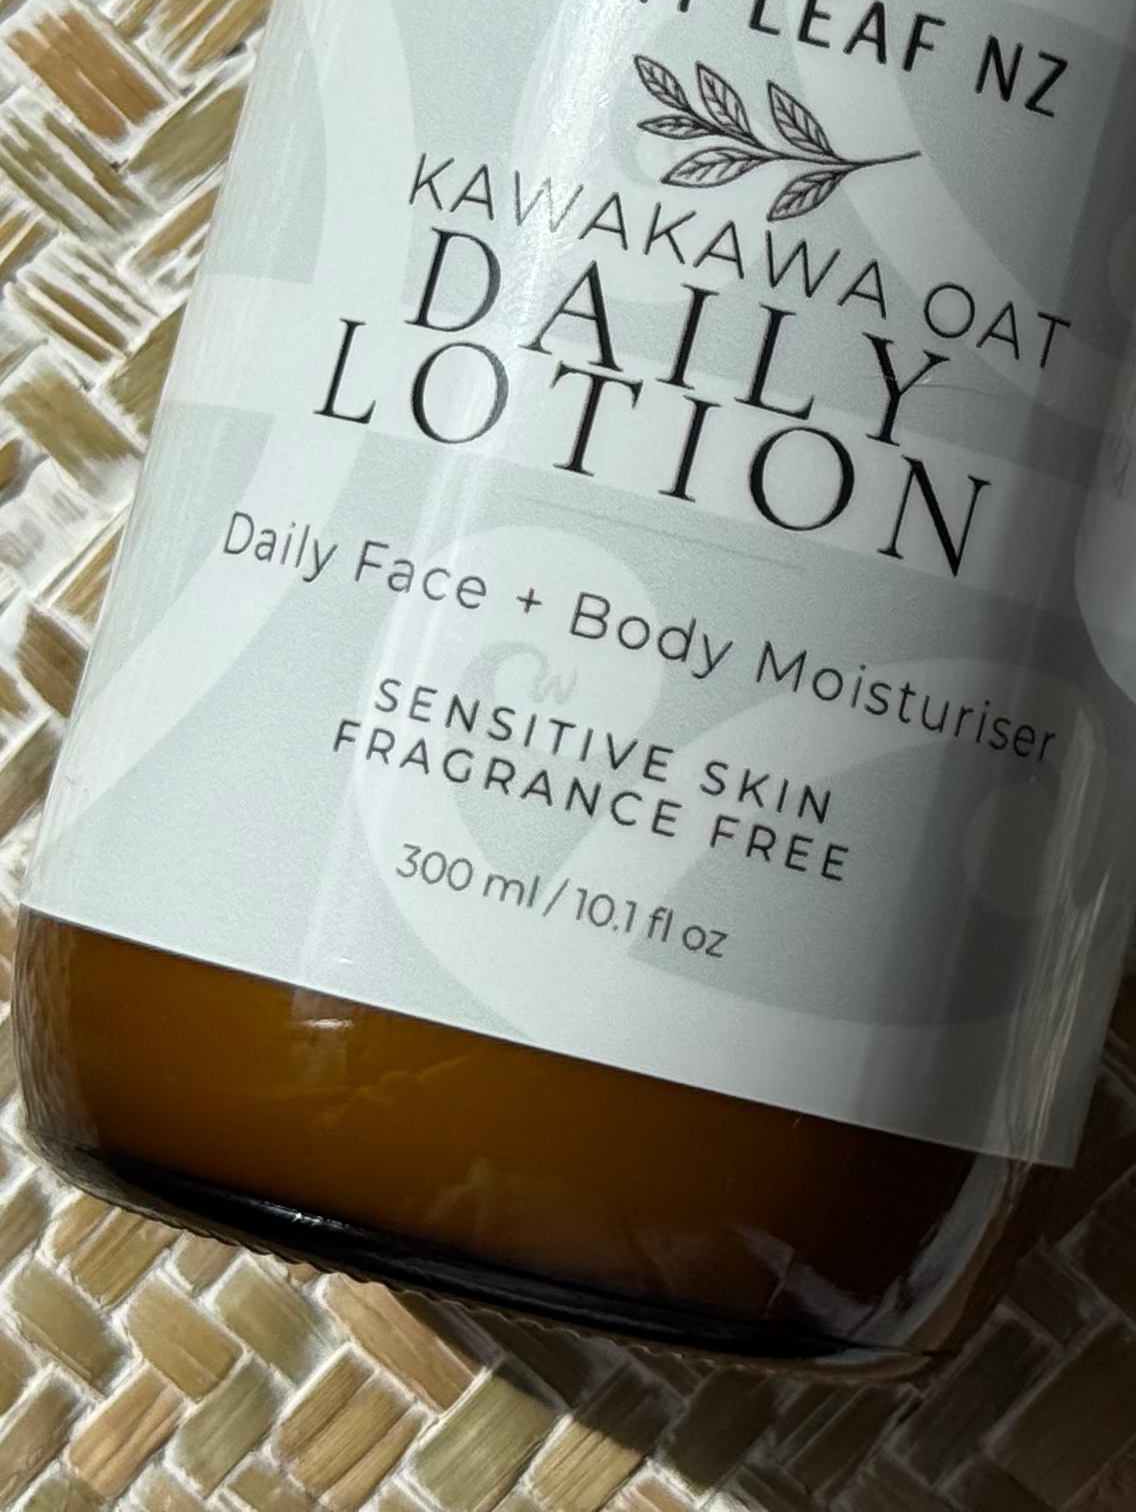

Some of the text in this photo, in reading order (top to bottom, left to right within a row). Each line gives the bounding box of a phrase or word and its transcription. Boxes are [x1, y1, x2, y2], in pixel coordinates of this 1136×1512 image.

[974, 34, 1069, 119] NZ
[404, 227, 949, 447] DAILY
[408, 152, 1072, 370] KAWAKAWA OAT
[313, 317, 992, 578] LOTION
[222, 510, 338, 586] Daily
[353, 539, 488, 611] Face
[568, 590, 735, 681] Body
[755, 639, 1057, 764] Moisturiser
[332, 718, 850, 883] FRAGRANCE FREE
[375, 677, 832, 825] SENSITIVE SKIN
[396, 843, 474, 891] 300
[483, 874, 540, 908] ml
[575, 887, 637, 933] 10.1
[648, 905, 674, 943] fl
[682, 924, 728, 958] oz
